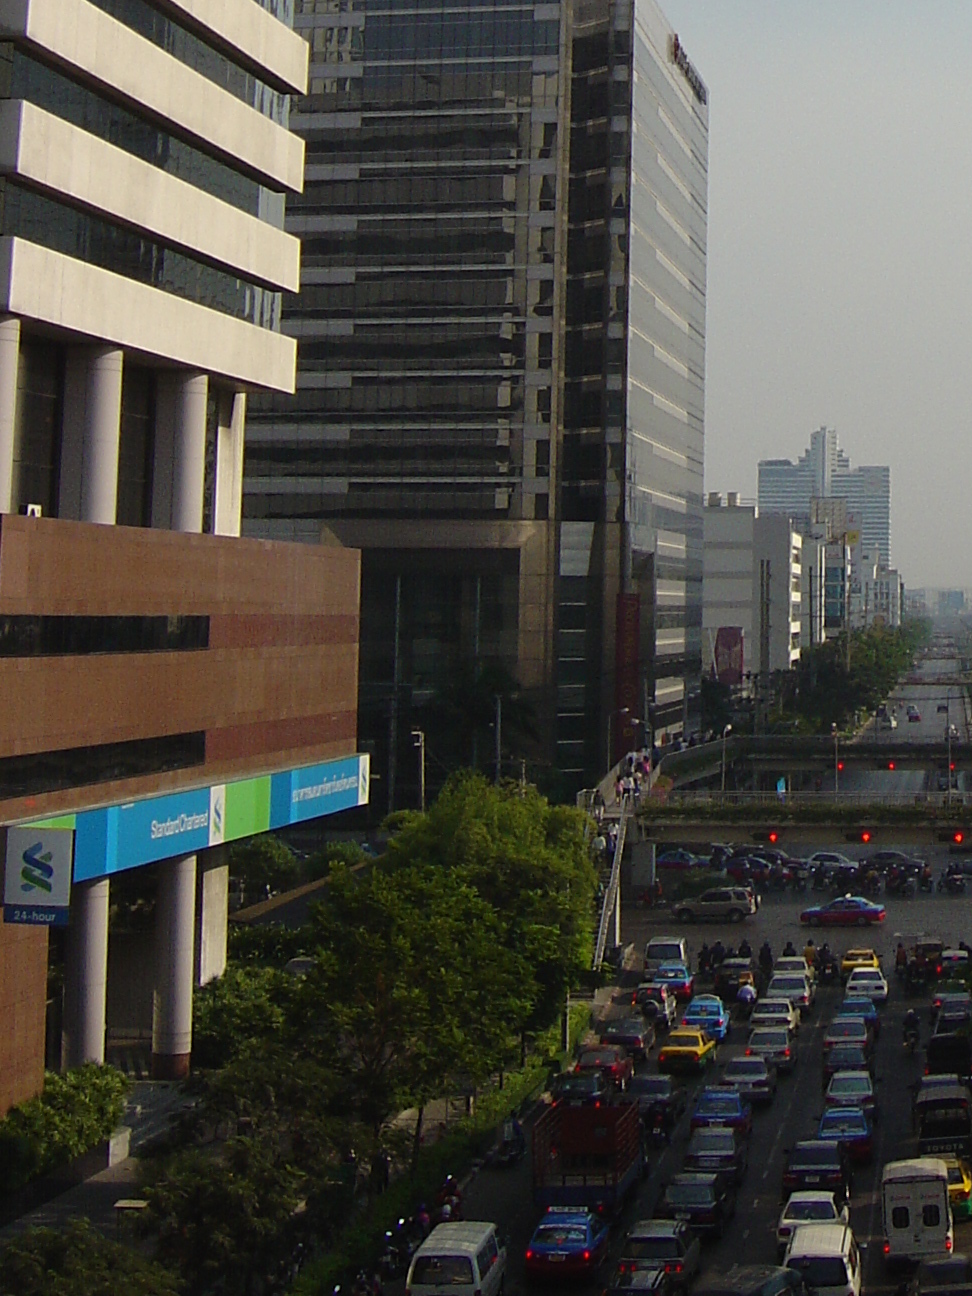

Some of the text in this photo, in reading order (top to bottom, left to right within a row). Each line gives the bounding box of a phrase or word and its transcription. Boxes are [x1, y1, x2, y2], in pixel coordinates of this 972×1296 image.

[151, 809, 208, 839] Standard Chartered
[14, 910, 56, 921] 24-hour
[927, 1143, 964, 1152] TOYOTA
